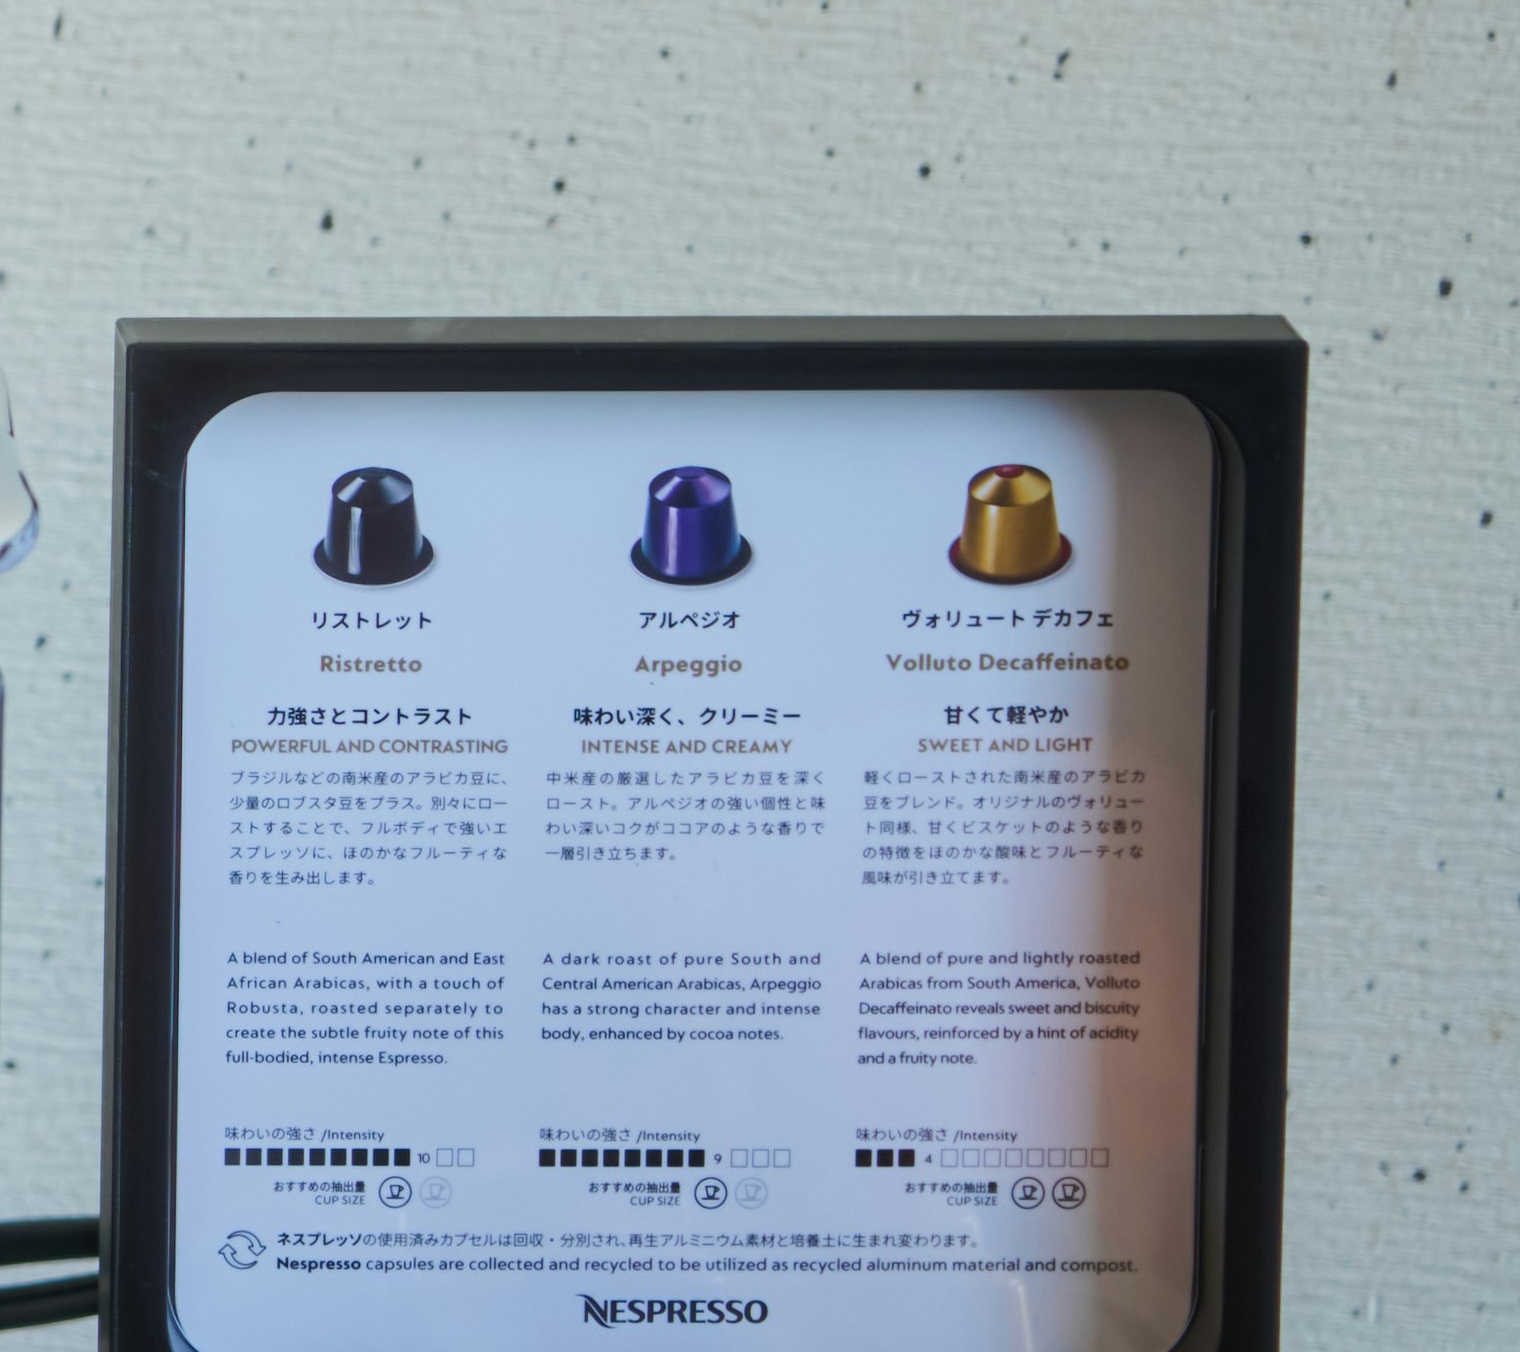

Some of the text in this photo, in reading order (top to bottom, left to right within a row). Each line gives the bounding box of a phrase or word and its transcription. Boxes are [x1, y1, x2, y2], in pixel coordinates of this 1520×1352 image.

[313, 611, 432, 631] リストレット
[639, 610, 741, 630] アルペジオ
[902, 607, 1114, 630] ヴォリュート デカフェ
[320, 653, 423, 674] Ristretto
[634, 653, 743, 678] Arpeggio
[885, 651, 1130, 672] Volluto Decaffeinato
[267, 706, 472, 727] 力強さとコントラスト
[573, 706, 801, 727] 味わい深く、クリーミー
[943, 704, 1069, 726] 甘くて軽やか
[231, 738, 509, 754] POWERFUL AND CONTRASTING
[581, 738, 793, 755] INTENSE AND CREAMY
[917, 736, 1094, 754] SWEET AND LIGHT
[228, 869, 374, 886] 香りを生み出します。
[227, 950, 505, 966] A blend of South American and East
[542, 951, 821, 969] A dark roast of pure South and
[859, 950, 1141, 968] A blend of pure and lightly roasted
[226, 975, 505, 992] African Arabicas, with a touch of
[542, 976, 822, 994] Central American Arabicas, Arpeggio
[858, 975, 1141, 992] Arabicas from South America, Volluto
[226, 1000, 504, 1018] Robusta, roasted separately to
[541, 1001, 821, 1020] has a strong character and intense
[858, 1000, 1140, 1018] Decaffeinato reveals sweet and biscuity
[225, 1025, 504, 1043] create the subtle fruity note of this
[541, 1026, 784, 1044] body, enhanced by cocoa notes.
[857, 1025, 1140, 1043] flavours, reinforced by a hint of acidity
[225, 1049, 448, 1068] full-bodied, intense Espresso.
[856, 1050, 978, 1068] and a fruity note.
[224, 1126, 316, 1142] 味わいの強さ
[539, 1126, 631, 1143] 味わいの強さ
[855, 1126, 948, 1143] 味わいの強さ
[417, 1152, 431, 1165] 10
[713, 1152, 723, 1165] 9
[924, 1153, 933, 1164] 4
[273, 1180, 366, 1194] おすすめの抽出量
[588, 1181, 681, 1195] おすすめの抽出量
[905, 1181, 999, 1195] おすすめの抽出量
[314, 1194, 366, 1206] CUP SIZE
[629, 1195, 681, 1207] CUP SIZE
[946, 1195, 998, 1207] CUP SIZE
[276, 1256, 1139, 1275] Nespresso capsules are collected and recycled to be utilized as recycled aluminum material and compost.
[576, 1294, 769, 1328] NESPRESSO
